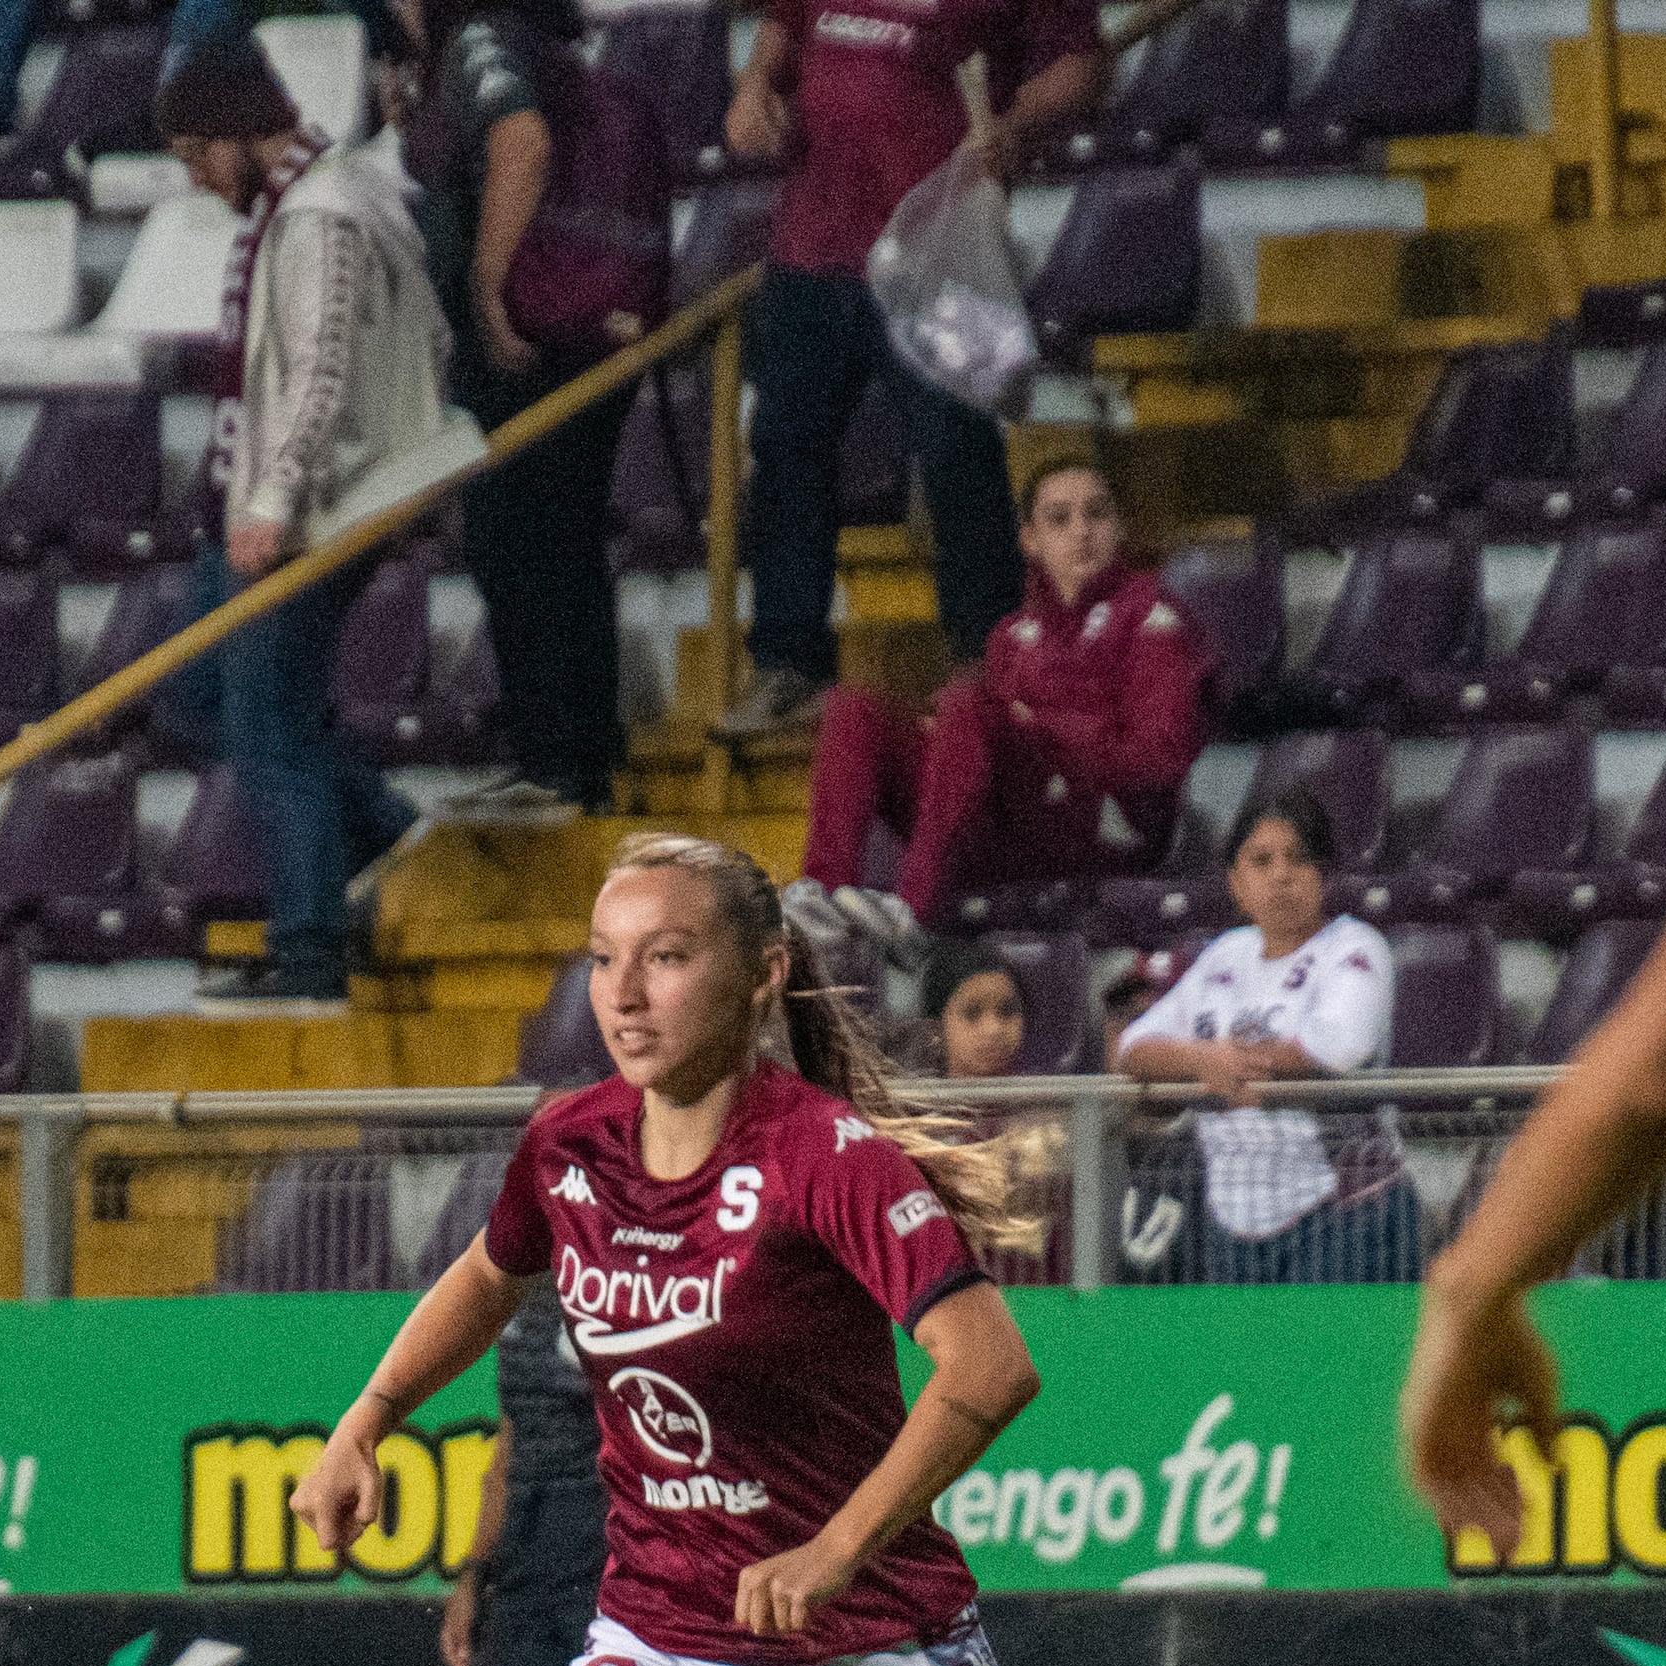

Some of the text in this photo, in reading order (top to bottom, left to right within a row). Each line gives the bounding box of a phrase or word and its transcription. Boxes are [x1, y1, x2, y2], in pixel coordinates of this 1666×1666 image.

[716, 1165, 763, 1232] S
[557, 1244, 725, 1324] Dorival
[933, 1466, 1145, 1562] engo
